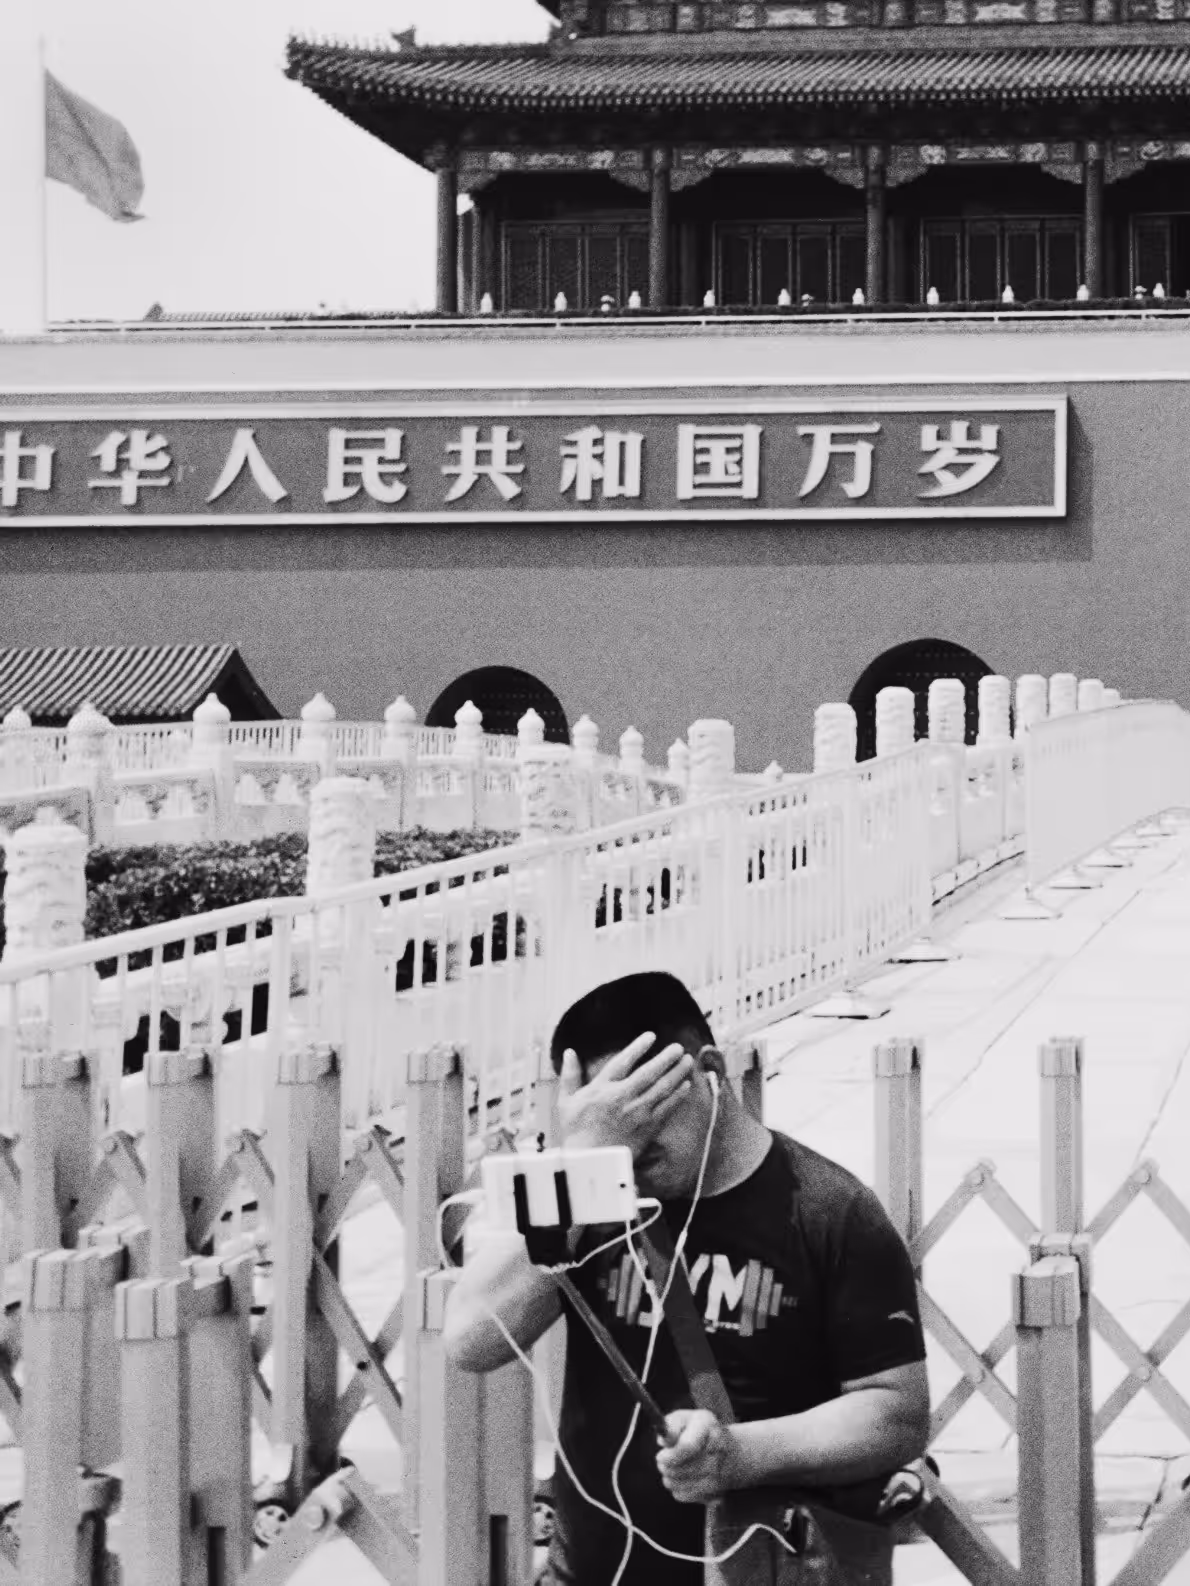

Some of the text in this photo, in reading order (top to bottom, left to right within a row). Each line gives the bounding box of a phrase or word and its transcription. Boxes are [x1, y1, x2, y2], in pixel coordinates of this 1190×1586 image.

[0, 420, 1001, 506] 中华人民共和国万岁
